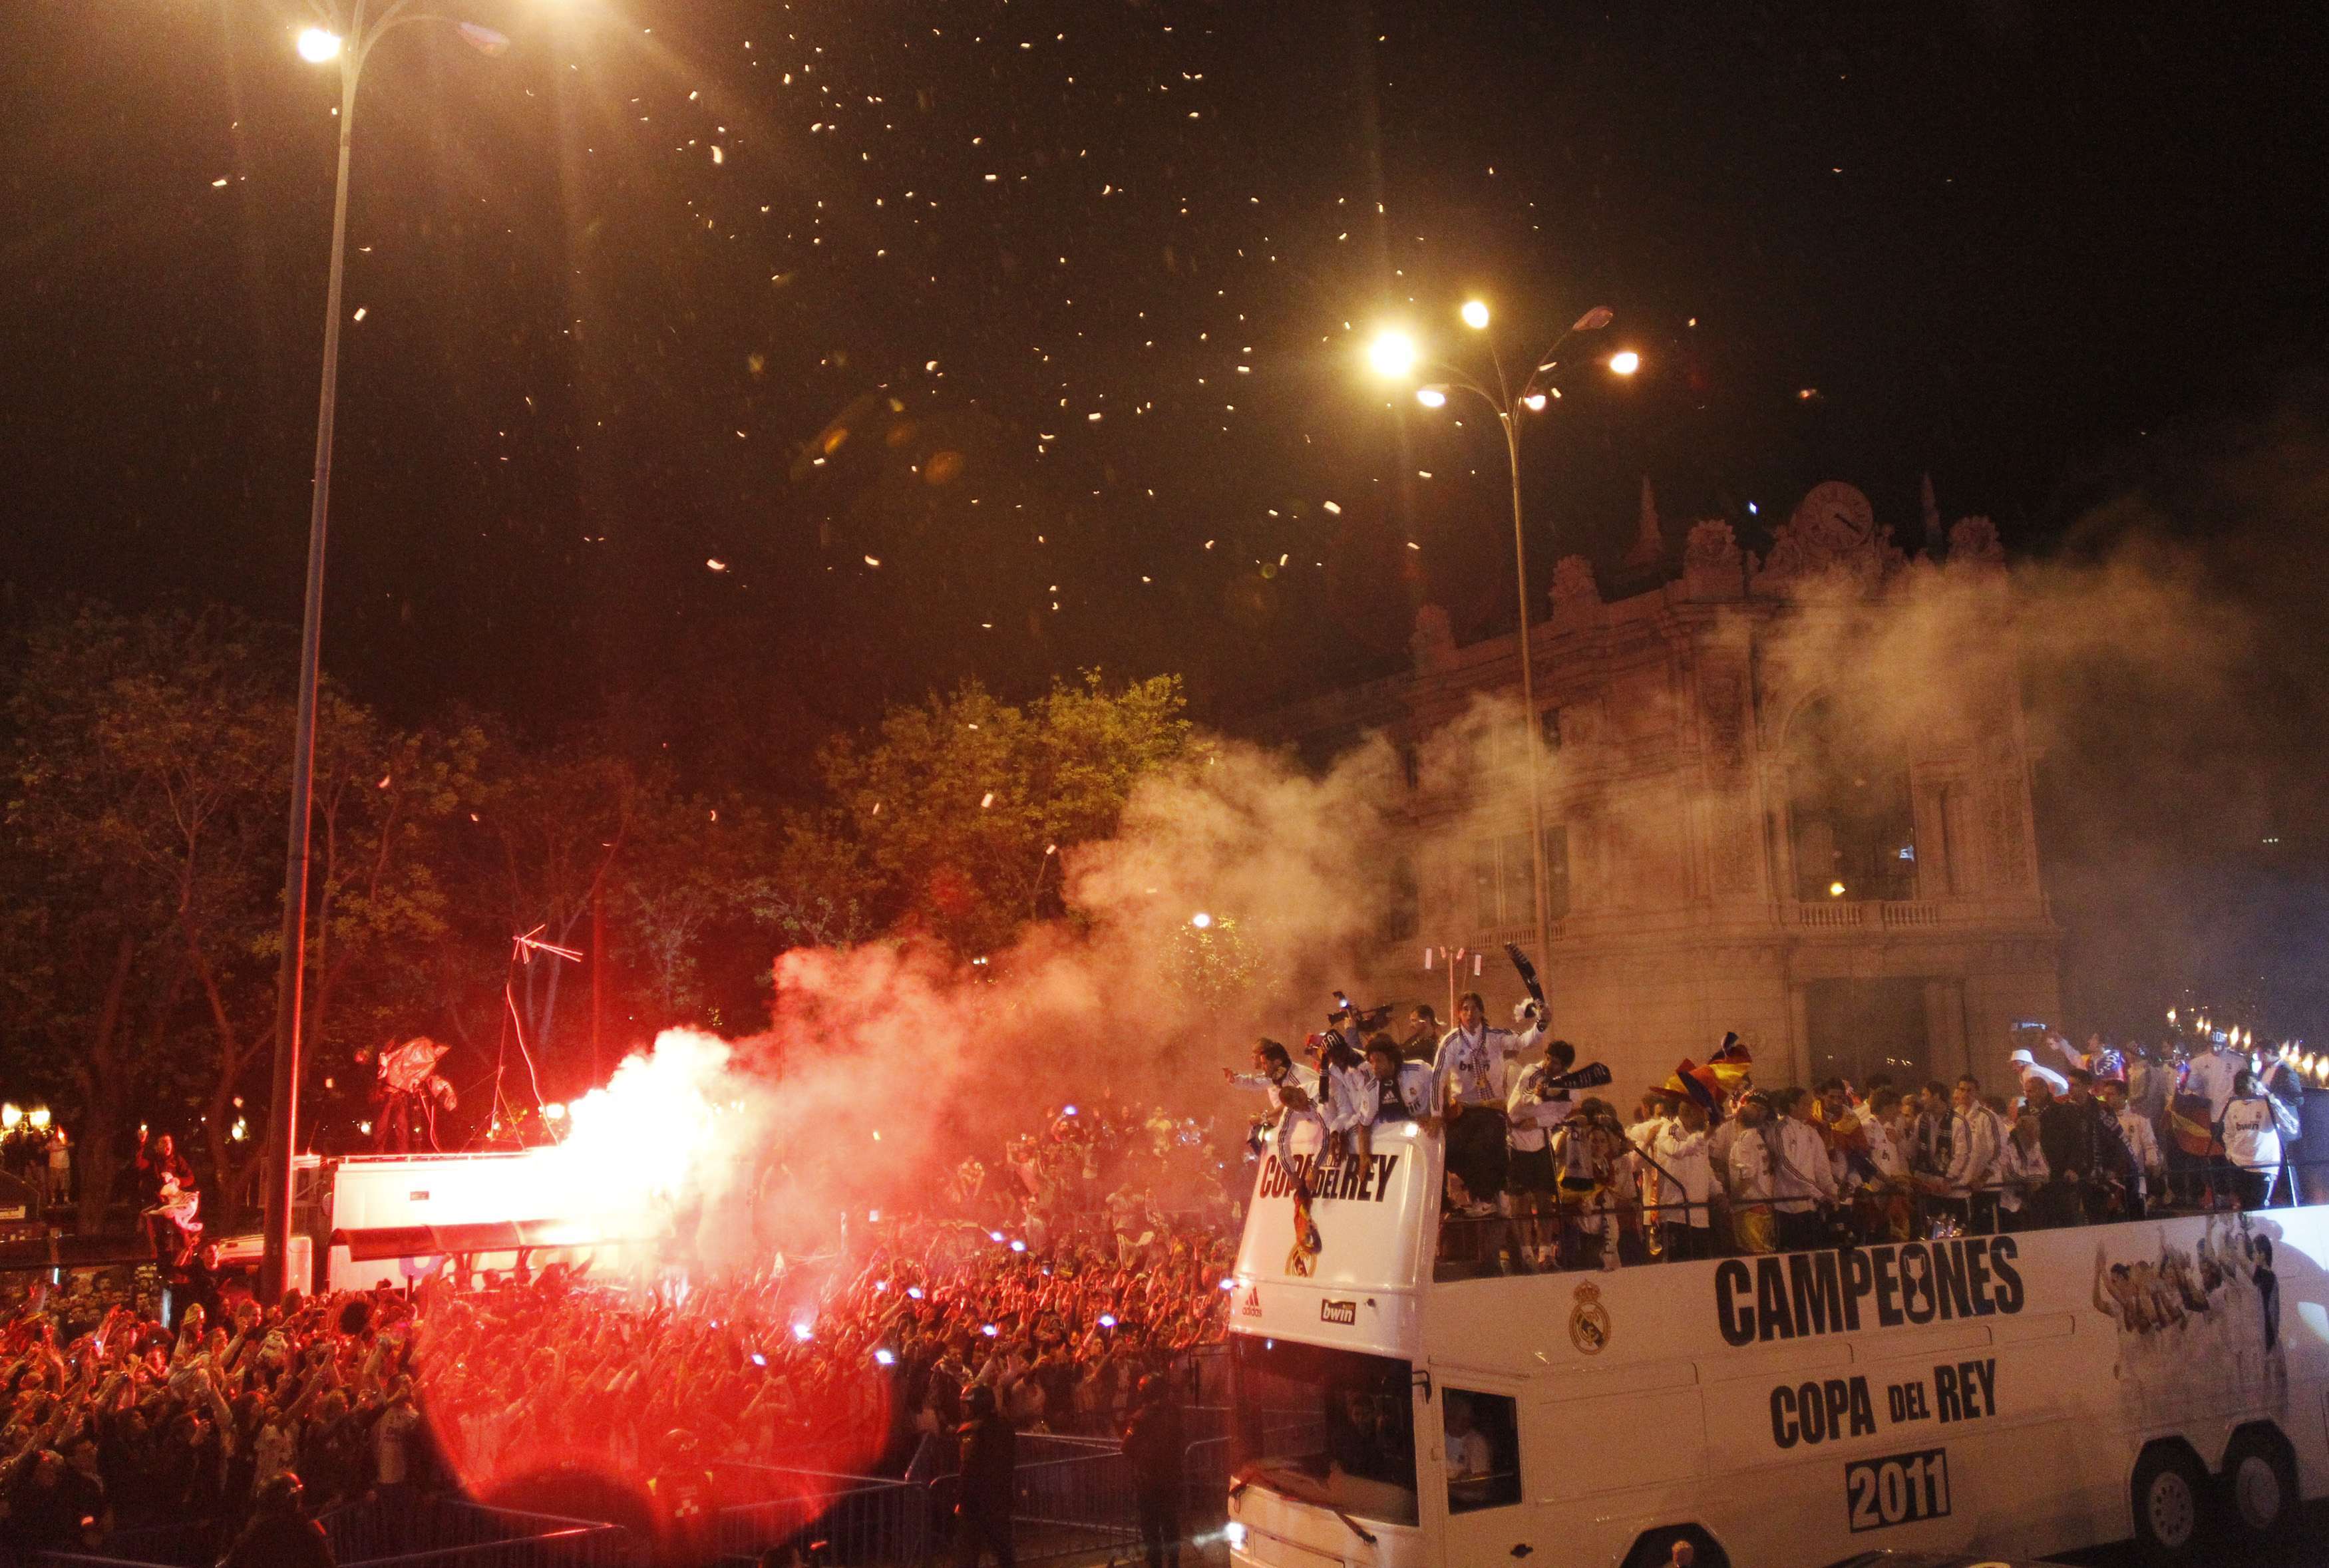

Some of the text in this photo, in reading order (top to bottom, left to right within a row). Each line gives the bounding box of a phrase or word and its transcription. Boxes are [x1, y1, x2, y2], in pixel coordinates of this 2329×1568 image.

[1313, 1169, 1344, 1199] DEL
[1339, 1154, 1400, 1202] REY
[1242, 1306, 1262, 1318] adidas
[1322, 1302, 1353, 1323] bwin
[1714, 1235, 2025, 1347] CAMPEONES
[1769, 1358, 1996, 1449] COPA DEL REY
[1848, 1454, 1950, 1529] 2011
